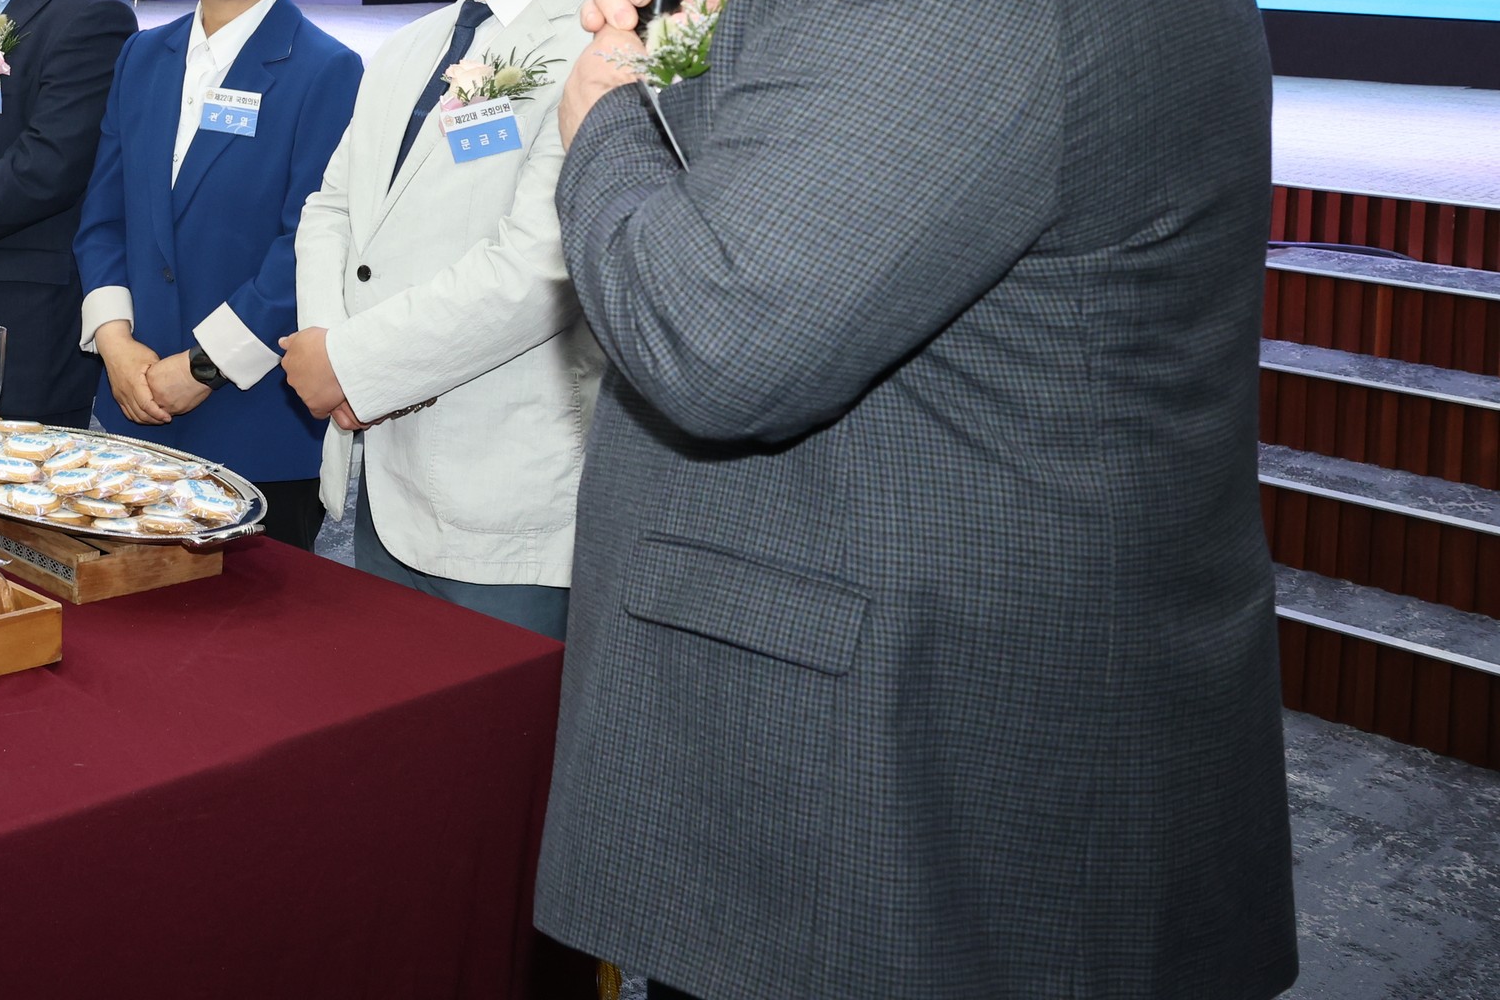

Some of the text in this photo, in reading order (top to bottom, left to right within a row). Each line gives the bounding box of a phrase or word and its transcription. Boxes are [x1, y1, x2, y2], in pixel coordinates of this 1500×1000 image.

[214, 93, 233, 103] 제22대
[454, 103, 511, 124] 제22대 국회의원
